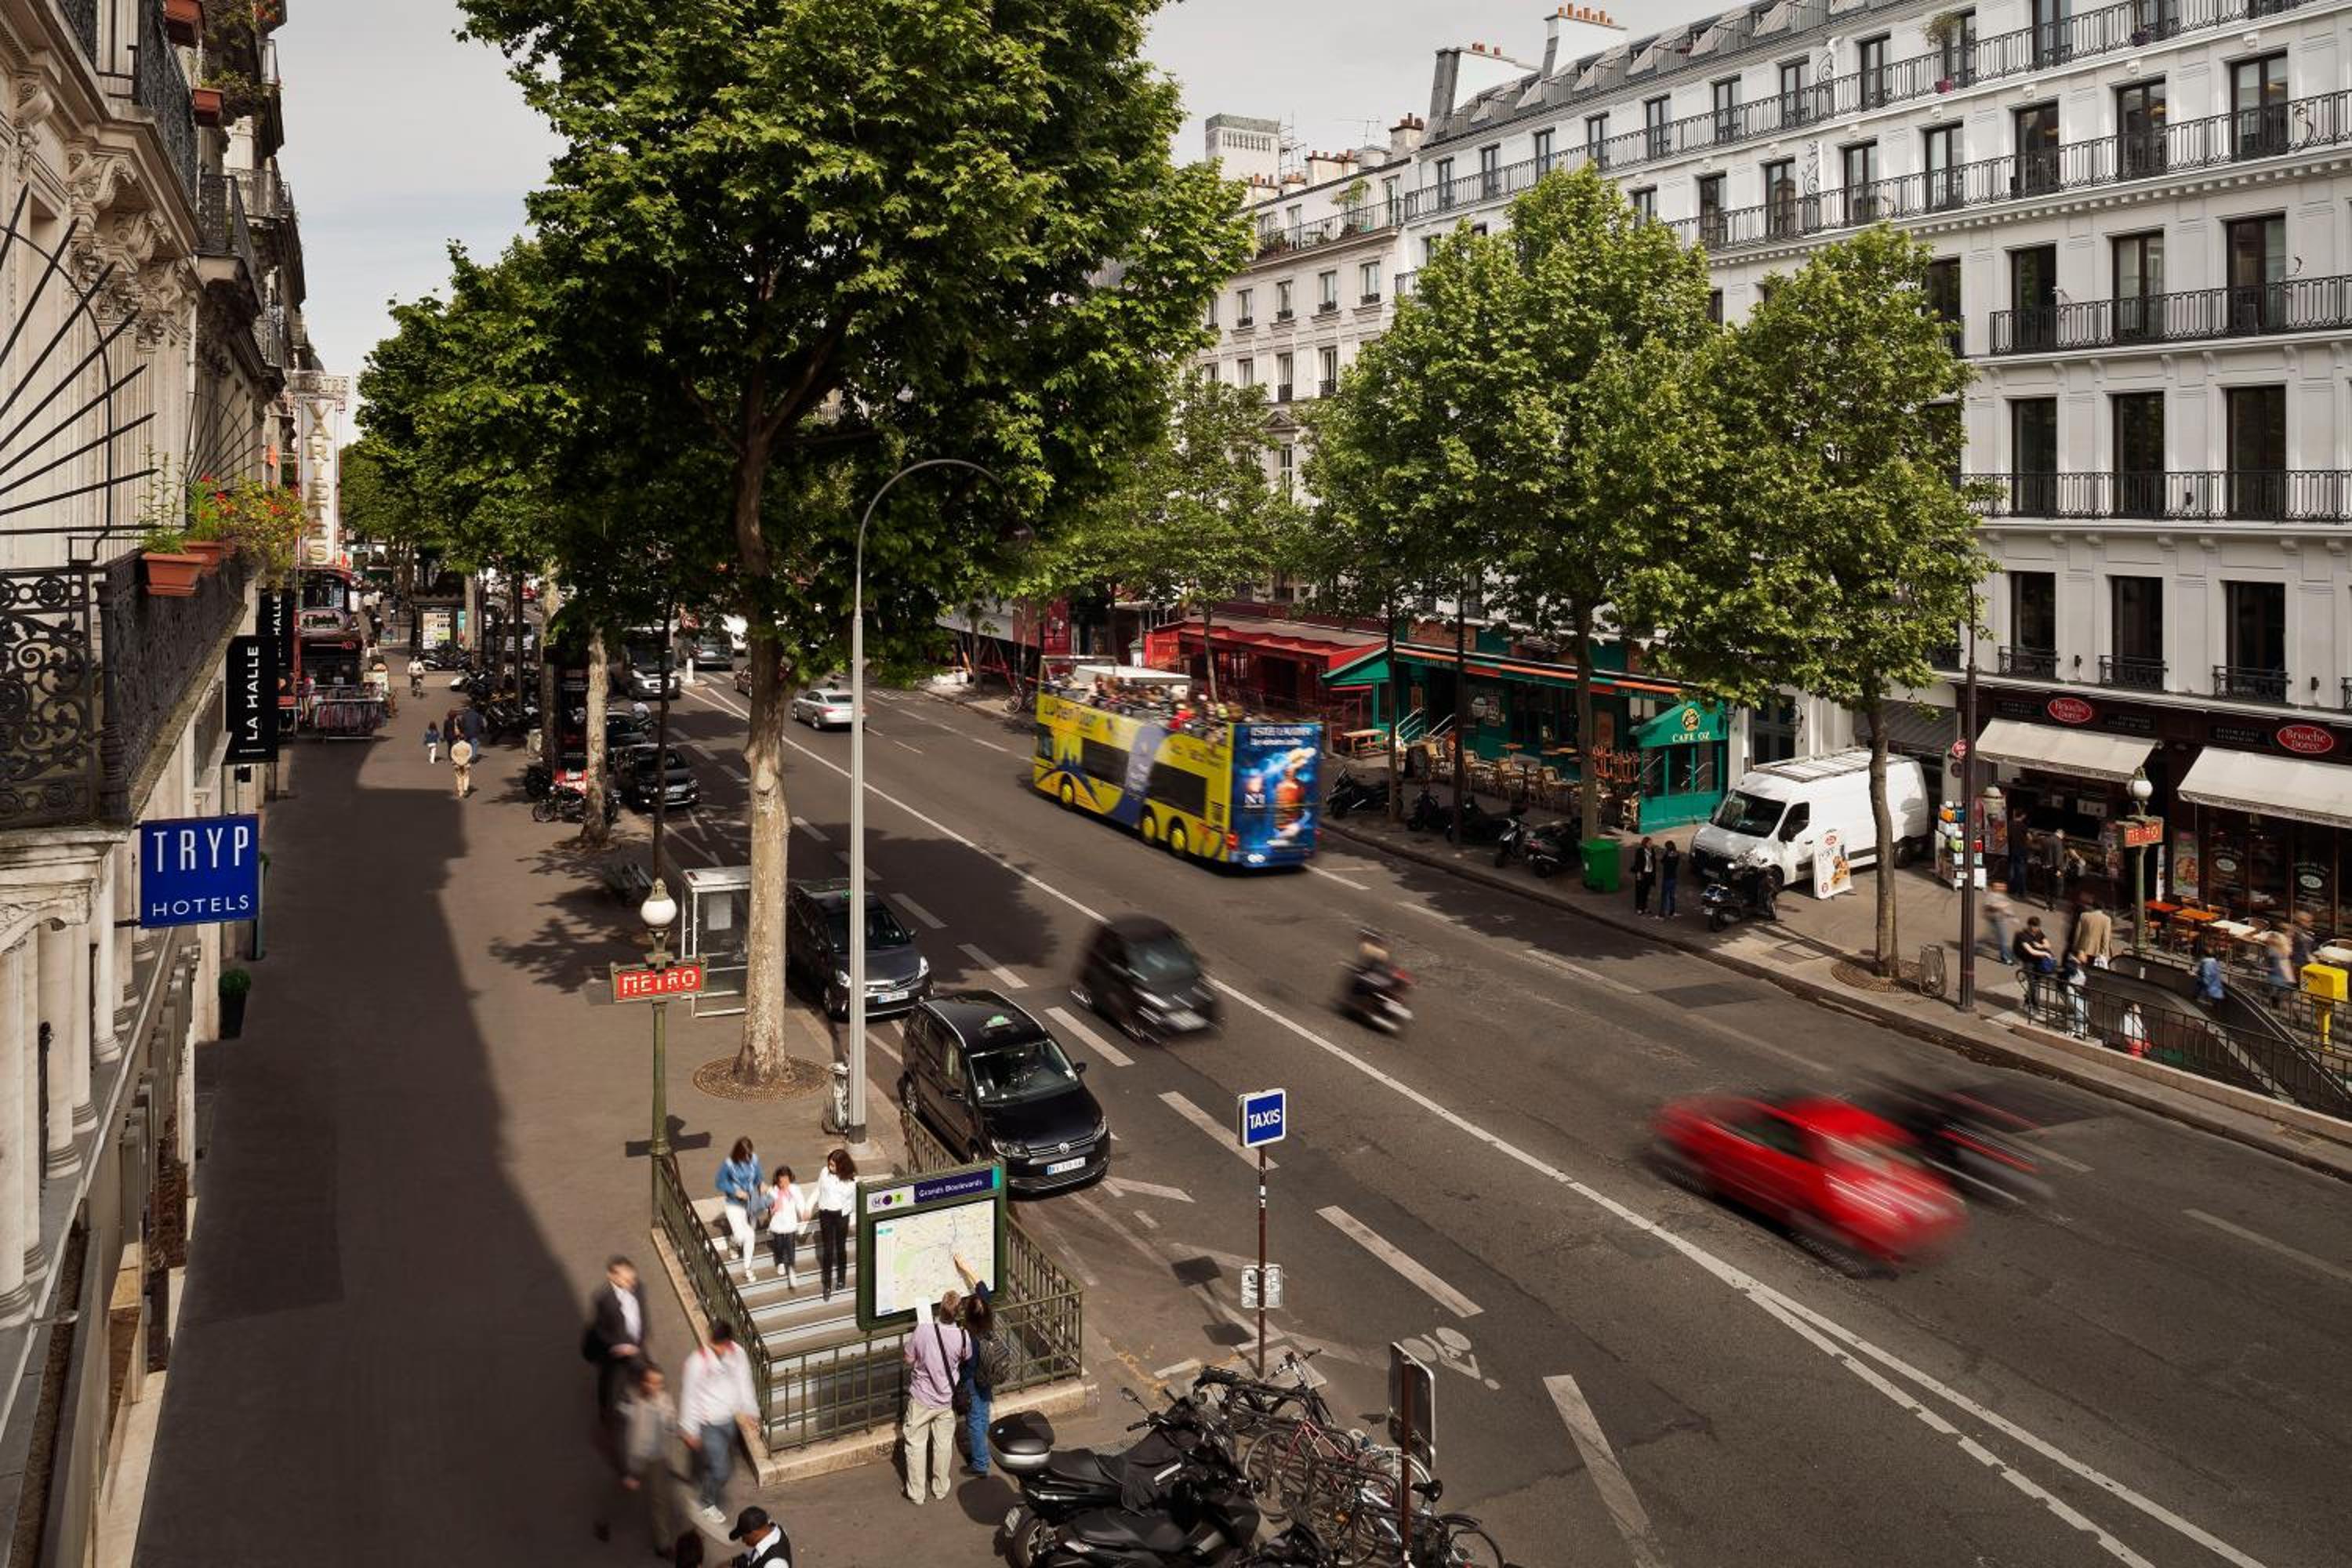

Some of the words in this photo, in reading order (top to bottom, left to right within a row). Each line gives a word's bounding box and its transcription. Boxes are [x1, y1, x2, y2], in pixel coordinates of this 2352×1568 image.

[272, 593, 282, 637] HALLE
[246, 645, 260, 709] HALLE
[245, 716, 260, 742] LA
[2285, 728, 2326, 743] Brioche
[153, 826, 249, 873] TRYP
[152, 895, 249, 916] HOTELS
[622, 969, 697, 994] METRO
[1249, 1109, 1280, 1130] TAXIS
[918, 1185, 945, 1198] Grands
[945, 1178, 983, 1192] Boulevards
